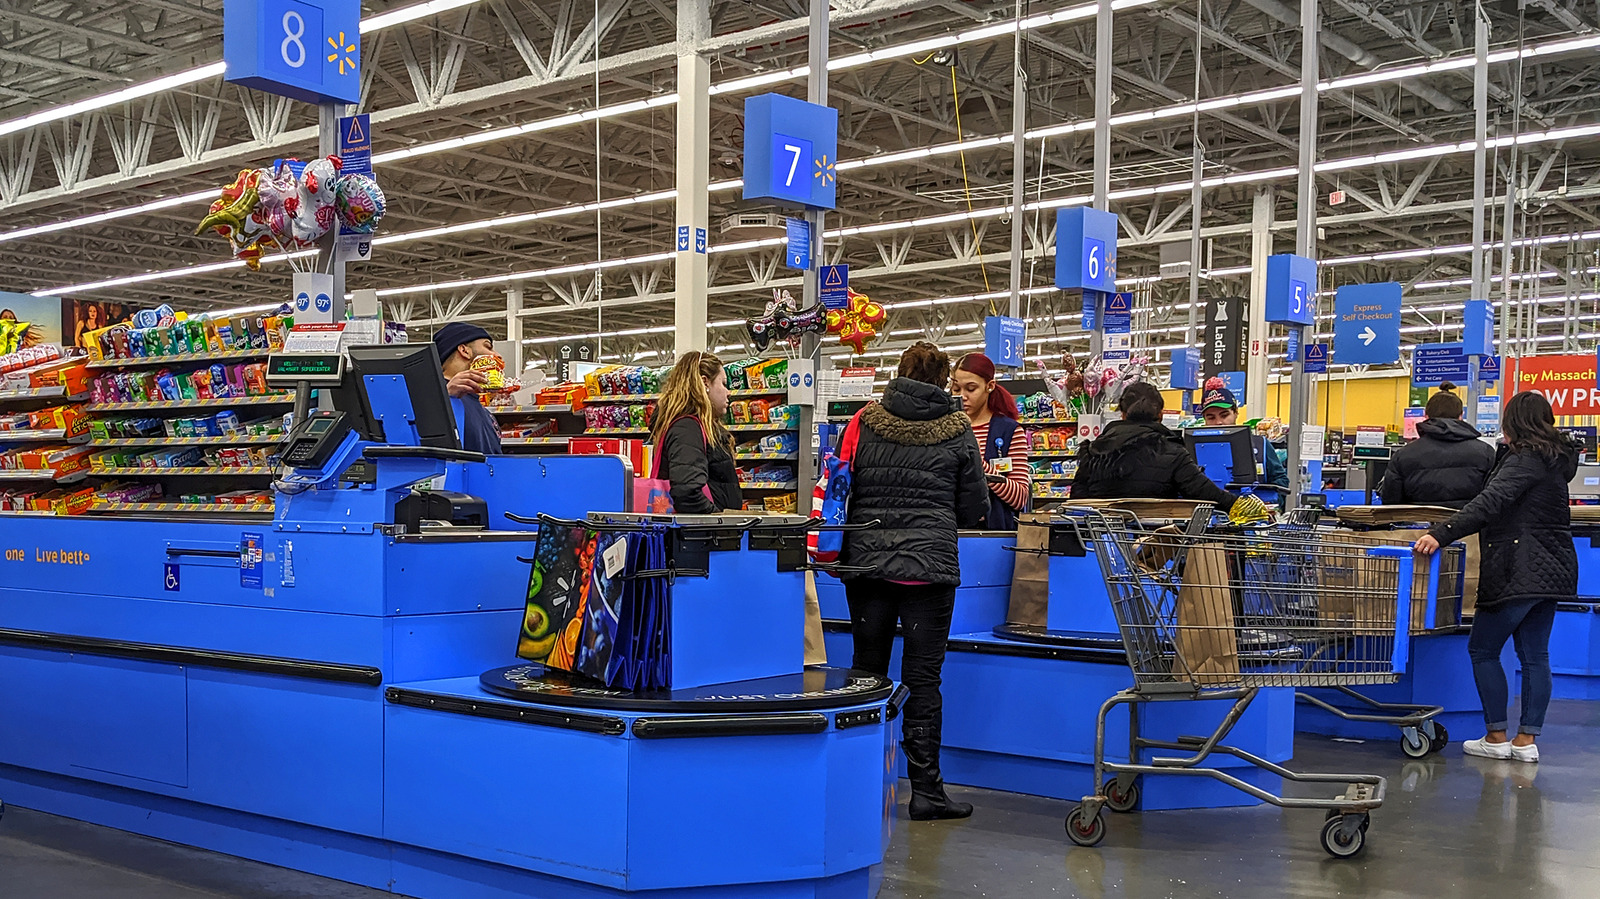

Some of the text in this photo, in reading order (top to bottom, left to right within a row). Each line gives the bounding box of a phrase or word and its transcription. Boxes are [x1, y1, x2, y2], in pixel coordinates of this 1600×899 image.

[281, 10, 306, 68] 8
[784, 144, 801, 187] 7
[1331, 194, 1343, 204] EXIT
[1088, 246, 1099, 279] 6
[1293, 286, 1302, 314] 5
[1353, 304, 1382, 312] Express
[1342, 312, 1393, 321] Self Checkout
[1004, 339, 1011, 360] 3
[1213, 325, 1227, 366] Ladies
[1240, 326, 1248, 366] Ladies
[172, 452, 192, 467] Extra
[5, 548, 25, 561] one
[36, 546, 58, 563] Live
